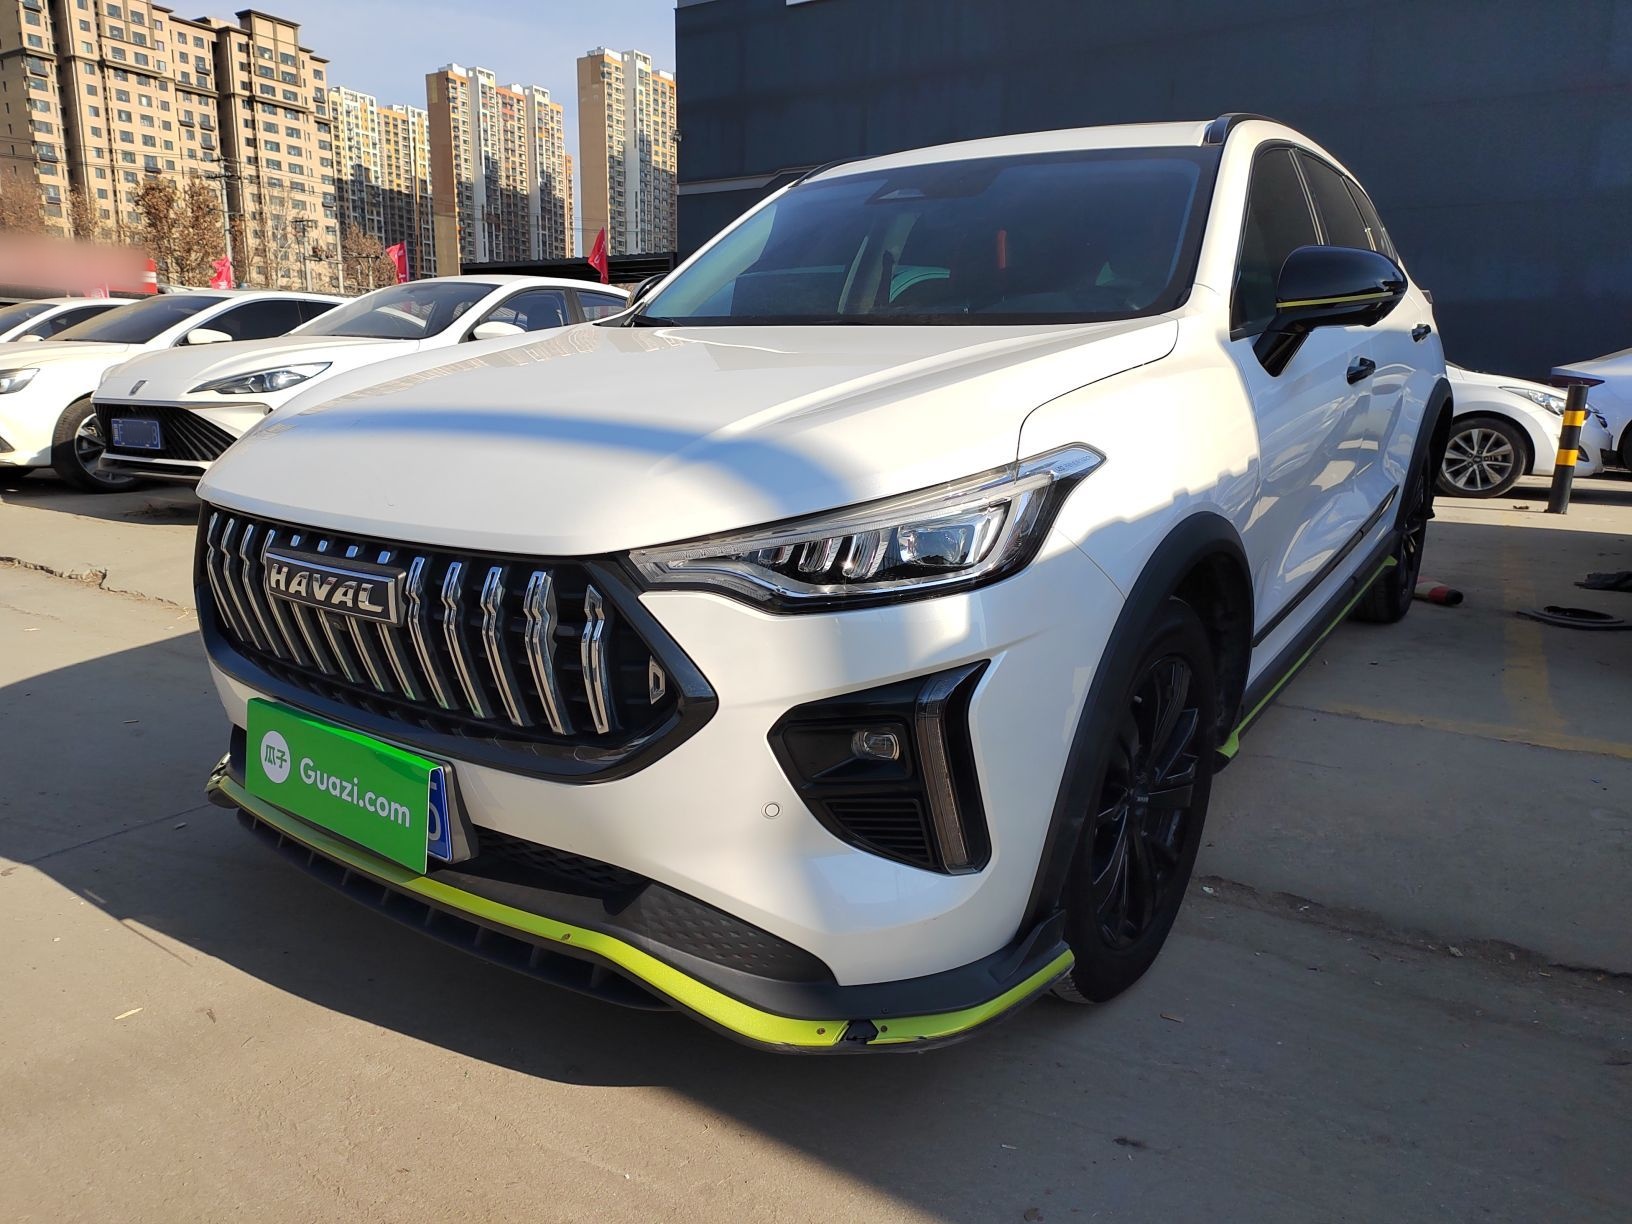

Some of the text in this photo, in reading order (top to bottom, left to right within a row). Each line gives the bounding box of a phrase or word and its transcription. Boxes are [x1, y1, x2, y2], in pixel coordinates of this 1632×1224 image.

[269, 563, 384, 613] HAVAL
[264, 744, 288, 769] 瓜子
[300, 757, 410, 828] Guazi.com
